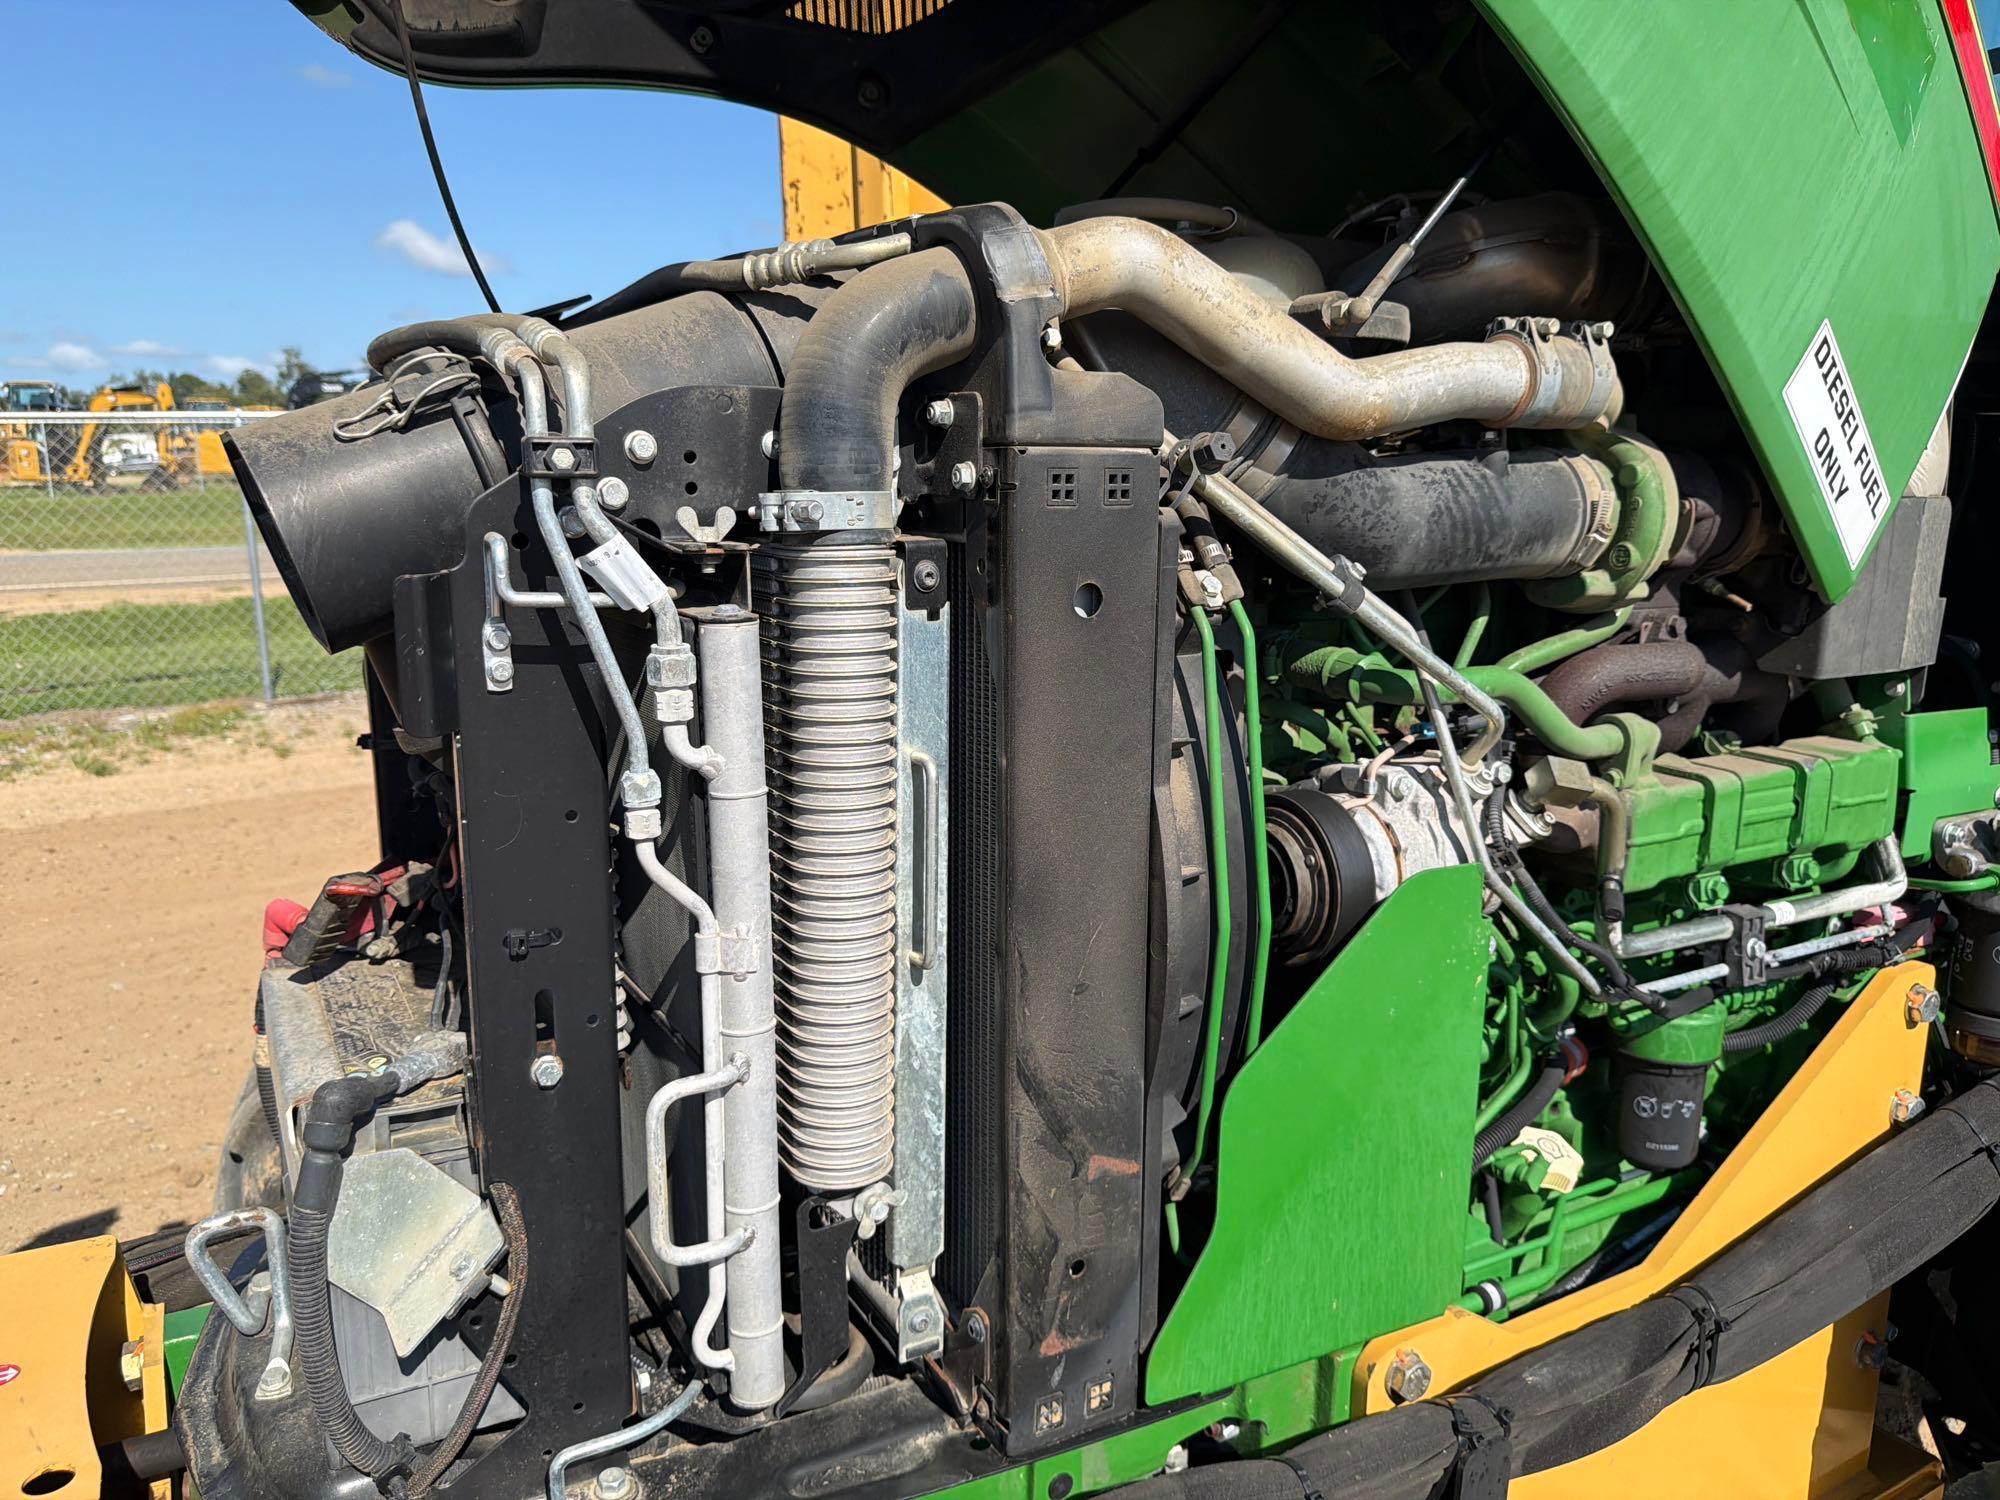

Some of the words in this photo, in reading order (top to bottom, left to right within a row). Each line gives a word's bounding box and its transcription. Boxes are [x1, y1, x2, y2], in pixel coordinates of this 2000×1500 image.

[1814, 335, 1859, 453] DIESEL
[1854, 443, 1883, 520] FUEL
[1814, 427, 1849, 504] ONLY
